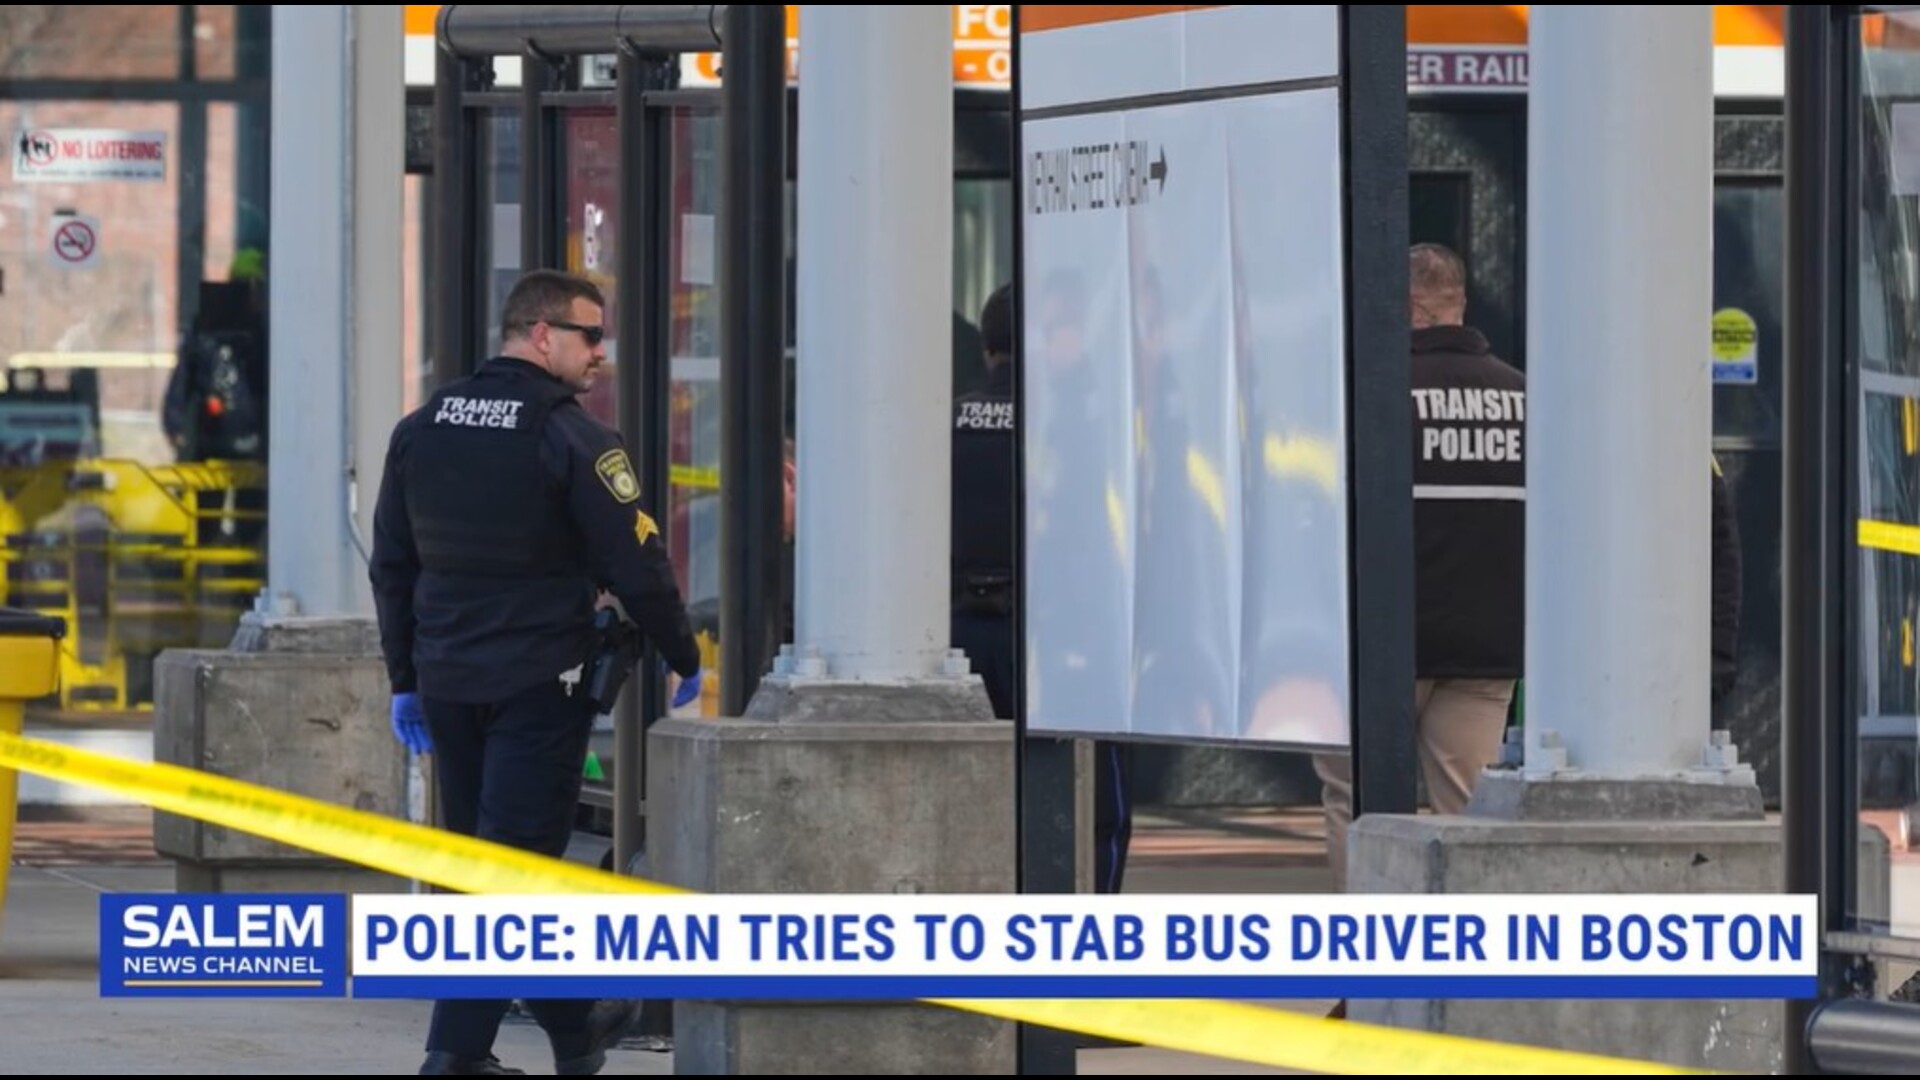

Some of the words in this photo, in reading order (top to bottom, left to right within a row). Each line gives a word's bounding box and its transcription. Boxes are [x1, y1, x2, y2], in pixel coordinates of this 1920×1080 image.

[1456, 55, 1528, 83] RAIL
[61, 140, 82, 159] NO
[87, 140, 162, 161] LOITERING
[441, 397, 523, 415] TRANSIT
[1411, 387, 1525, 421] TRANSIT
[434, 411, 518, 429] POLICE
[1423, 427, 1521, 461] POLICE
